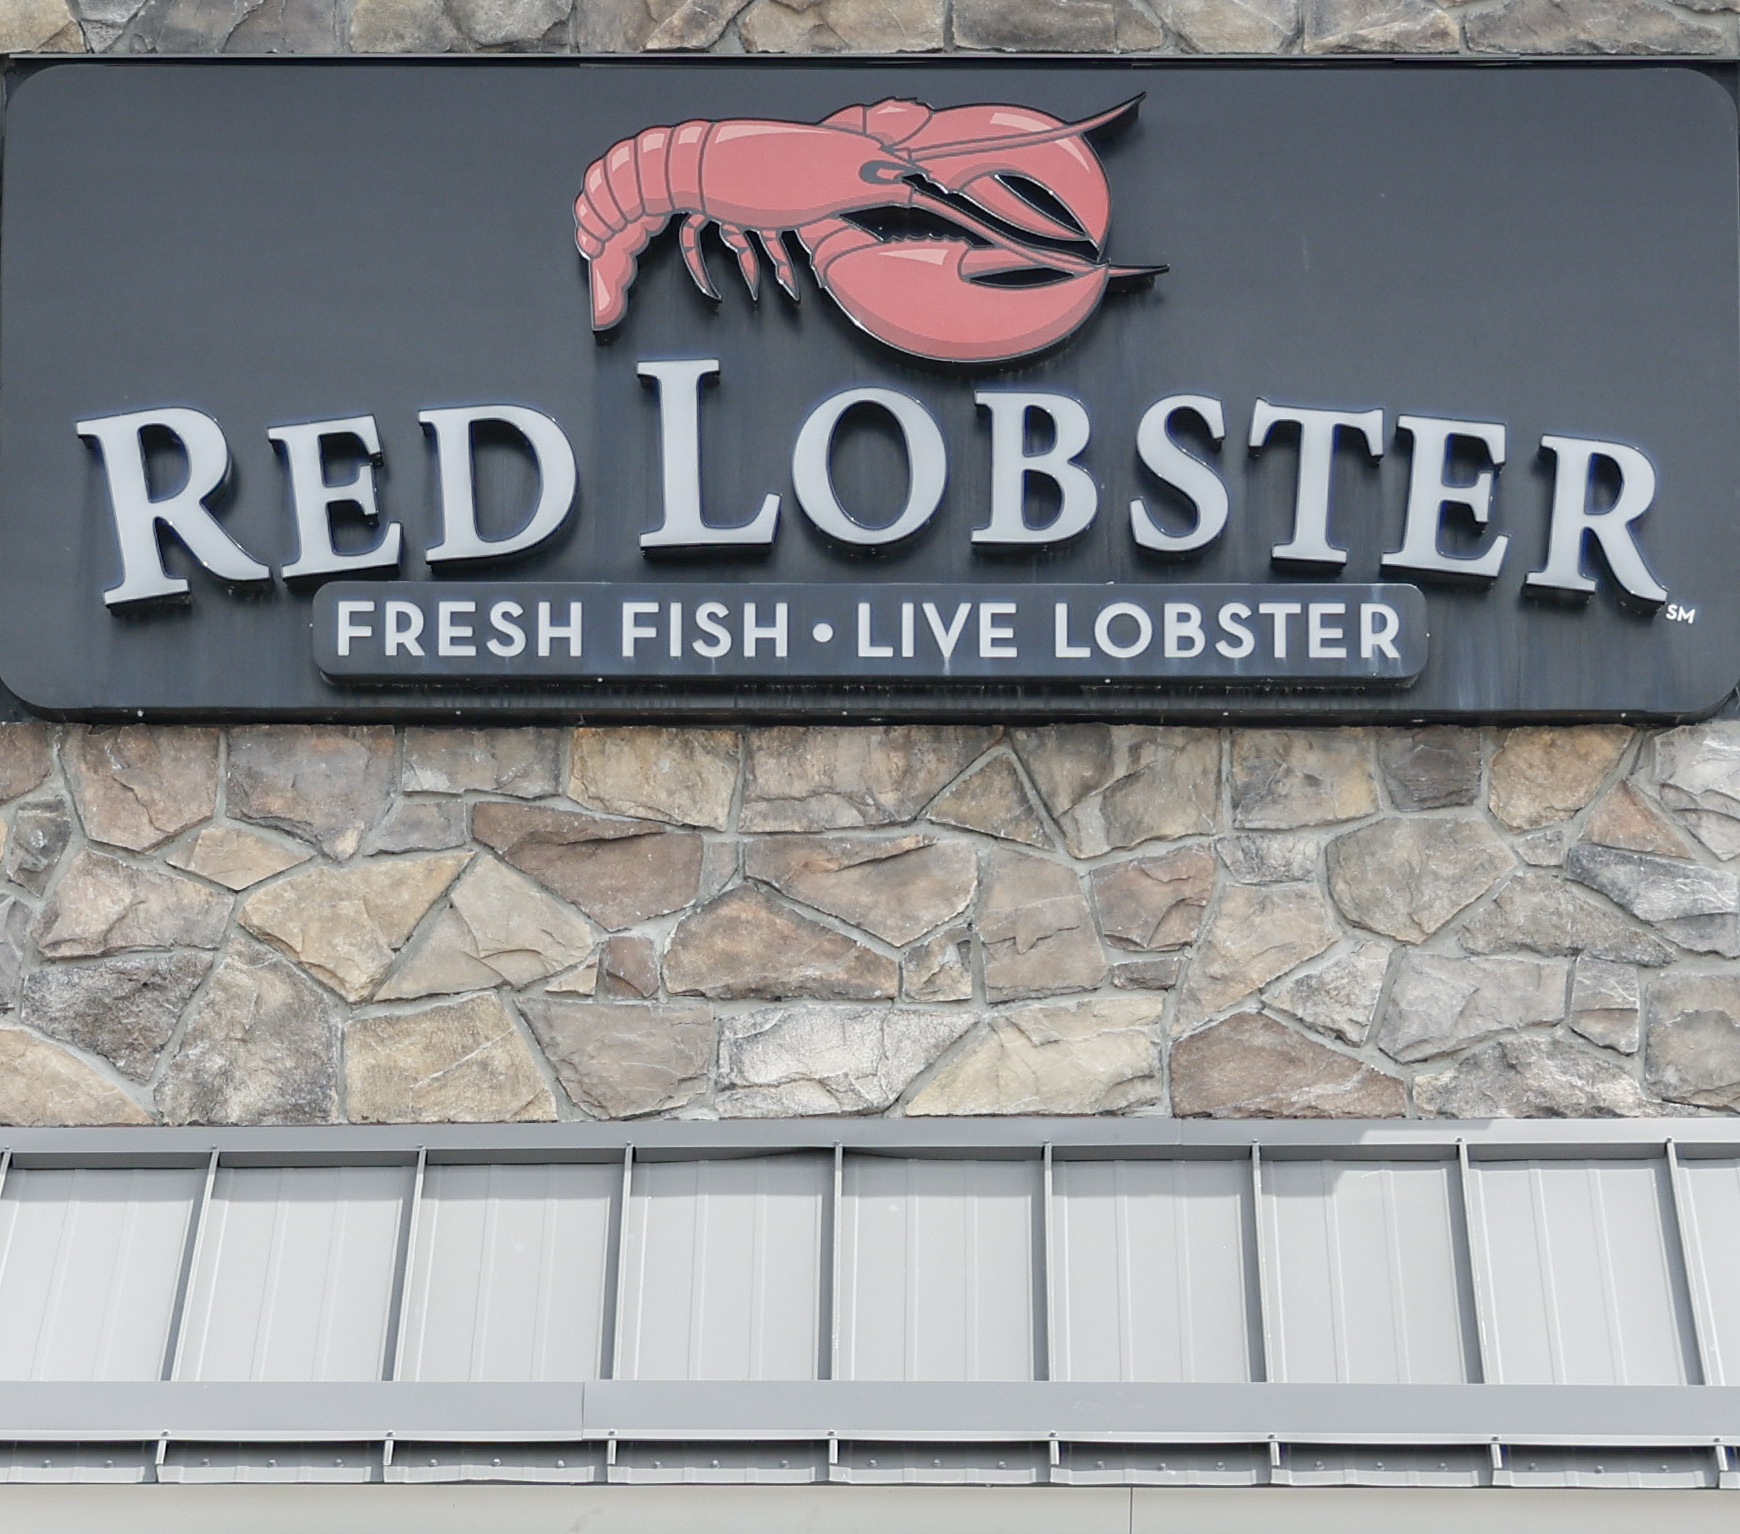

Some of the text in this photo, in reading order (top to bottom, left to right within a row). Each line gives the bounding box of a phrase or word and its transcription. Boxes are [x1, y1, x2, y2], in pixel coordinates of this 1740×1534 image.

[76, 358, 1668, 612] RED LOBSTER
[333, 600, 1402, 659] FRESH FISH LIVE LOBSTER
[1665, 604, 1696, 624] SM
